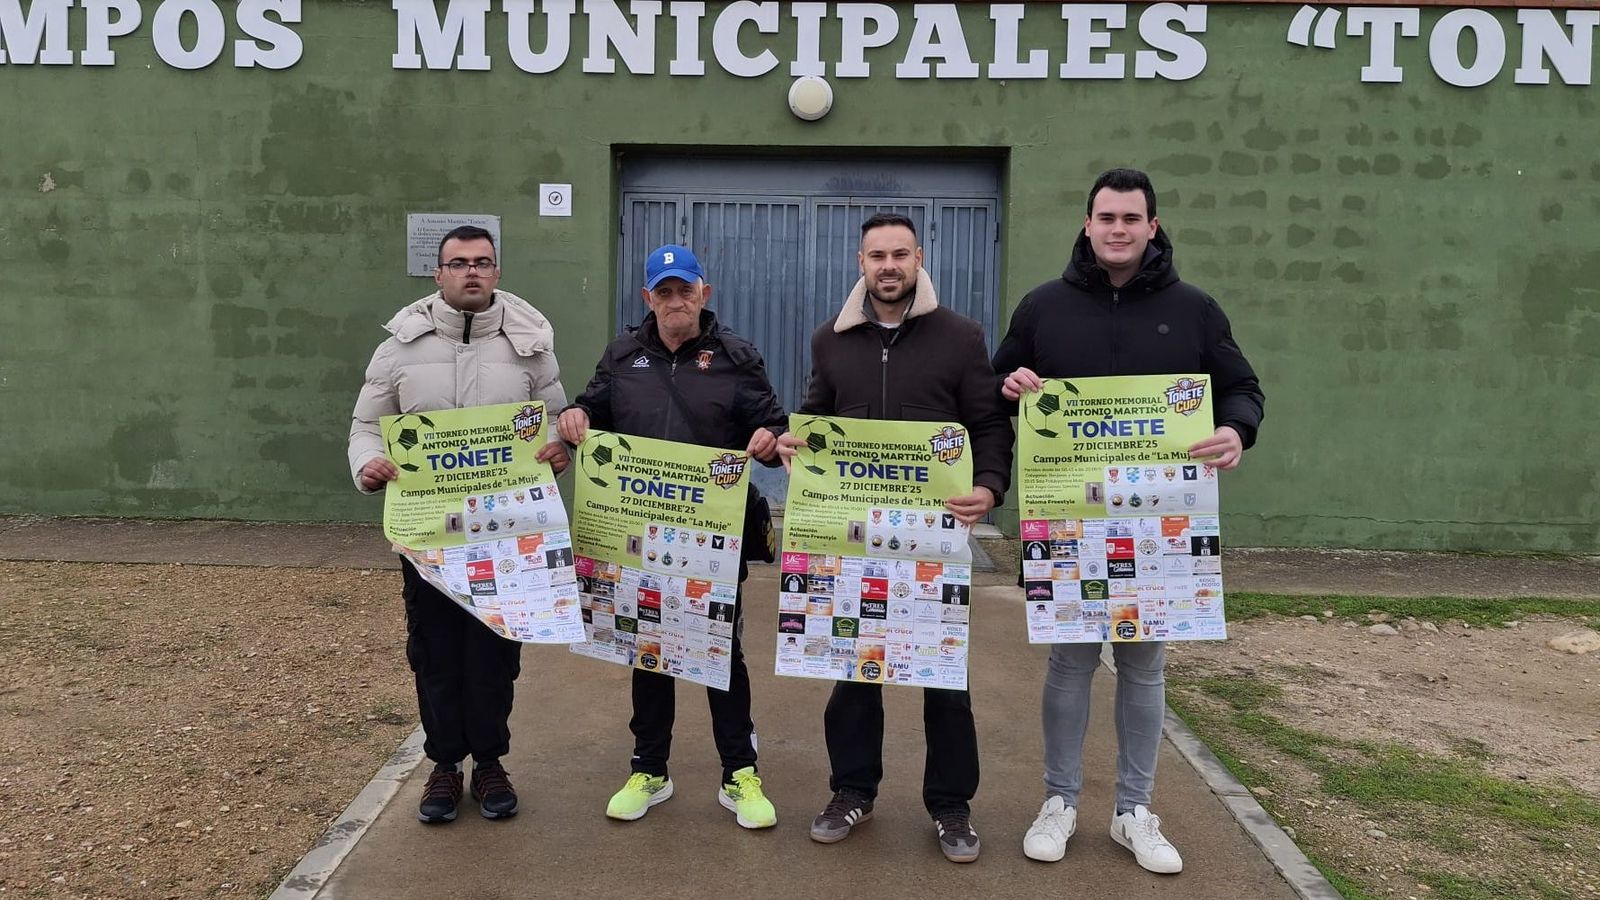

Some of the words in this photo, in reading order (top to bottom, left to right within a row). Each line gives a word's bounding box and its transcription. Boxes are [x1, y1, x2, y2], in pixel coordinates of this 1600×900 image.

[392, 0, 1207, 80] MUNICIPALES
[664, 252, 674, 264] B
[1080, 398, 1113, 406] TORNEO
[1114, 396, 1162, 405] MEMORIAL
[1063, 407, 1111, 416] ANTONIO
[1113, 404, 1167, 415] MARTIÑO
[424, 432, 434, 440] VII
[436, 429, 468, 439] TORNEO
[470, 424, 511, 435] MEMORIAL
[1068, 416, 1165, 438] TOÑETE
[422, 438, 467, 450] ANTONIO
[470, 431, 514, 446] MARTIÑO
[846, 441, 880, 450] TORNEO
[882, 443, 928, 452] MEMORIAL
[427, 446, 513, 470] TOÑETE
[618, 454, 630, 462] VII
[630, 456, 663, 468] TORNEO
[664, 460, 706, 474] MEMORIAL
[830, 449, 878, 460] ANTONIO
[880, 450, 932, 462] MARTIÑO
[1033, 455, 1072, 464] Campos
[1074, 452, 1136, 464] Municipales
[1138, 452, 1150, 460] de
[1171, 450, 1190, 461] Muj
[434, 474, 444, 483] 27
[615, 464, 660, 476] ANTONIO
[662, 470, 709, 484] MARTIÑO
[836, 458, 929, 482] TOÑETE
[400, 486, 436, 498] Campos
[438, 482, 490, 496] Municipales
[492, 479, 502, 488] de
[618, 475, 704, 504] TOÑETE
[840, 482, 851, 490] 27
[620, 496, 631, 504] 27
[802, 489, 838, 502] Campos
[840, 492, 900, 506] Municipales
[902, 497, 914, 506] de
[586, 500, 619, 514] Campos
[621, 507, 674, 523] Municipales
[676, 516, 688, 524] de
